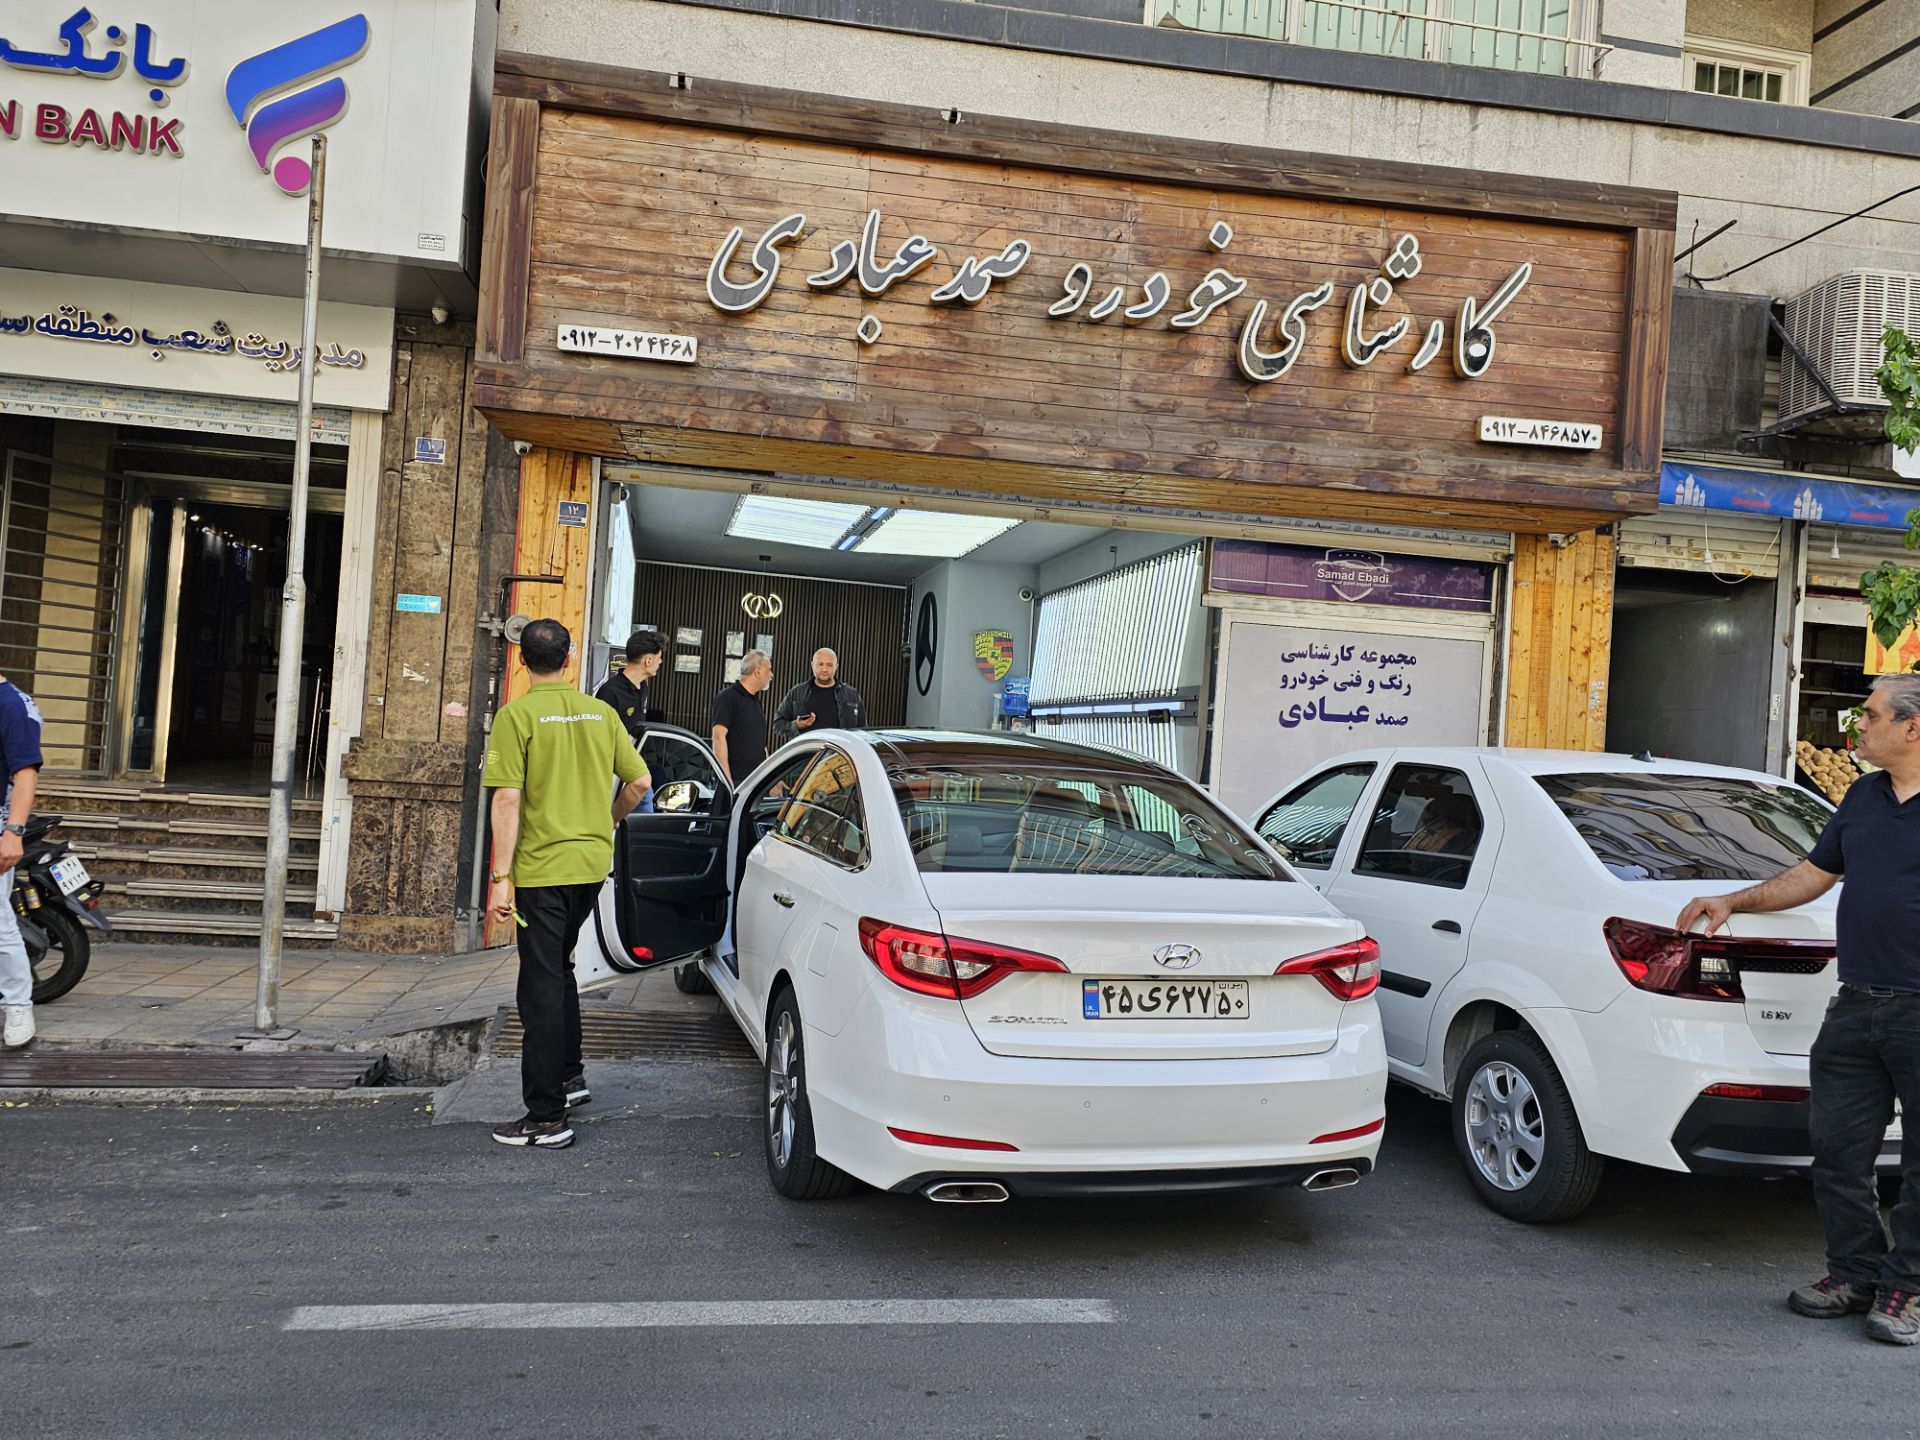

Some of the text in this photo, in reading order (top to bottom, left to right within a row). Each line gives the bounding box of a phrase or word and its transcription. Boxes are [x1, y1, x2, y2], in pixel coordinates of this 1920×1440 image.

[0, 6, 186, 101] بانک
[35, 103, 180, 153] BANK
[706, 208, 1532, 382] کارشناسی خودرو صمد عبادی
[34, 304, 136, 345] منطقه
[141, 320, 233, 361] شعب
[235, 332, 363, 371] مدریت
[1316, 567, 1389, 584] Samad Ebadi
[1280, 642, 1418, 670] مجموعه کارشناسی
[1279, 669, 1412, 697] رنگ و فنی خودرو
[1278, 695, 1409, 731] صمد عبادی
